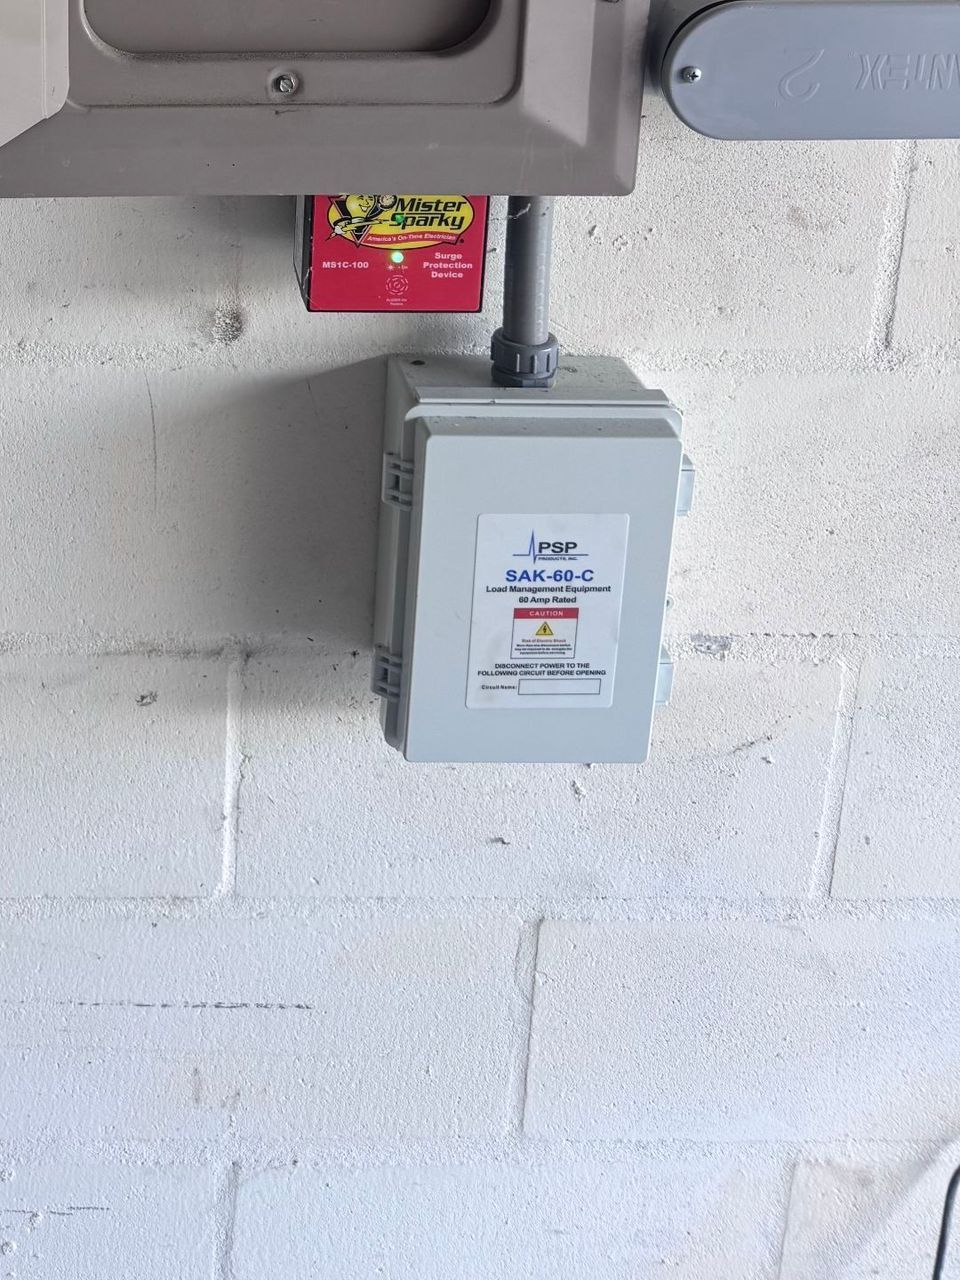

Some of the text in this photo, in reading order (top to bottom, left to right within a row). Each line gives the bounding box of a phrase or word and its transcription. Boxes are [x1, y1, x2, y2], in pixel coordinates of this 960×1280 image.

[395, 197, 467, 212] Mister
[389, 212, 465, 230] Sparky
[368, 232, 457, 242] America's On-Time Electrician
[434, 252, 463, 261] Surge
[322, 261, 369, 269] MS1C-100
[423, 261, 473, 269] Protection
[431, 270, 464, 278] Device
[538, 541, 578, 554] PSP
[505, 569, 594, 582] SAK-60-C
[486, 585, 611, 594] Load Management Equipment
[530, 596, 550, 604] Amp
